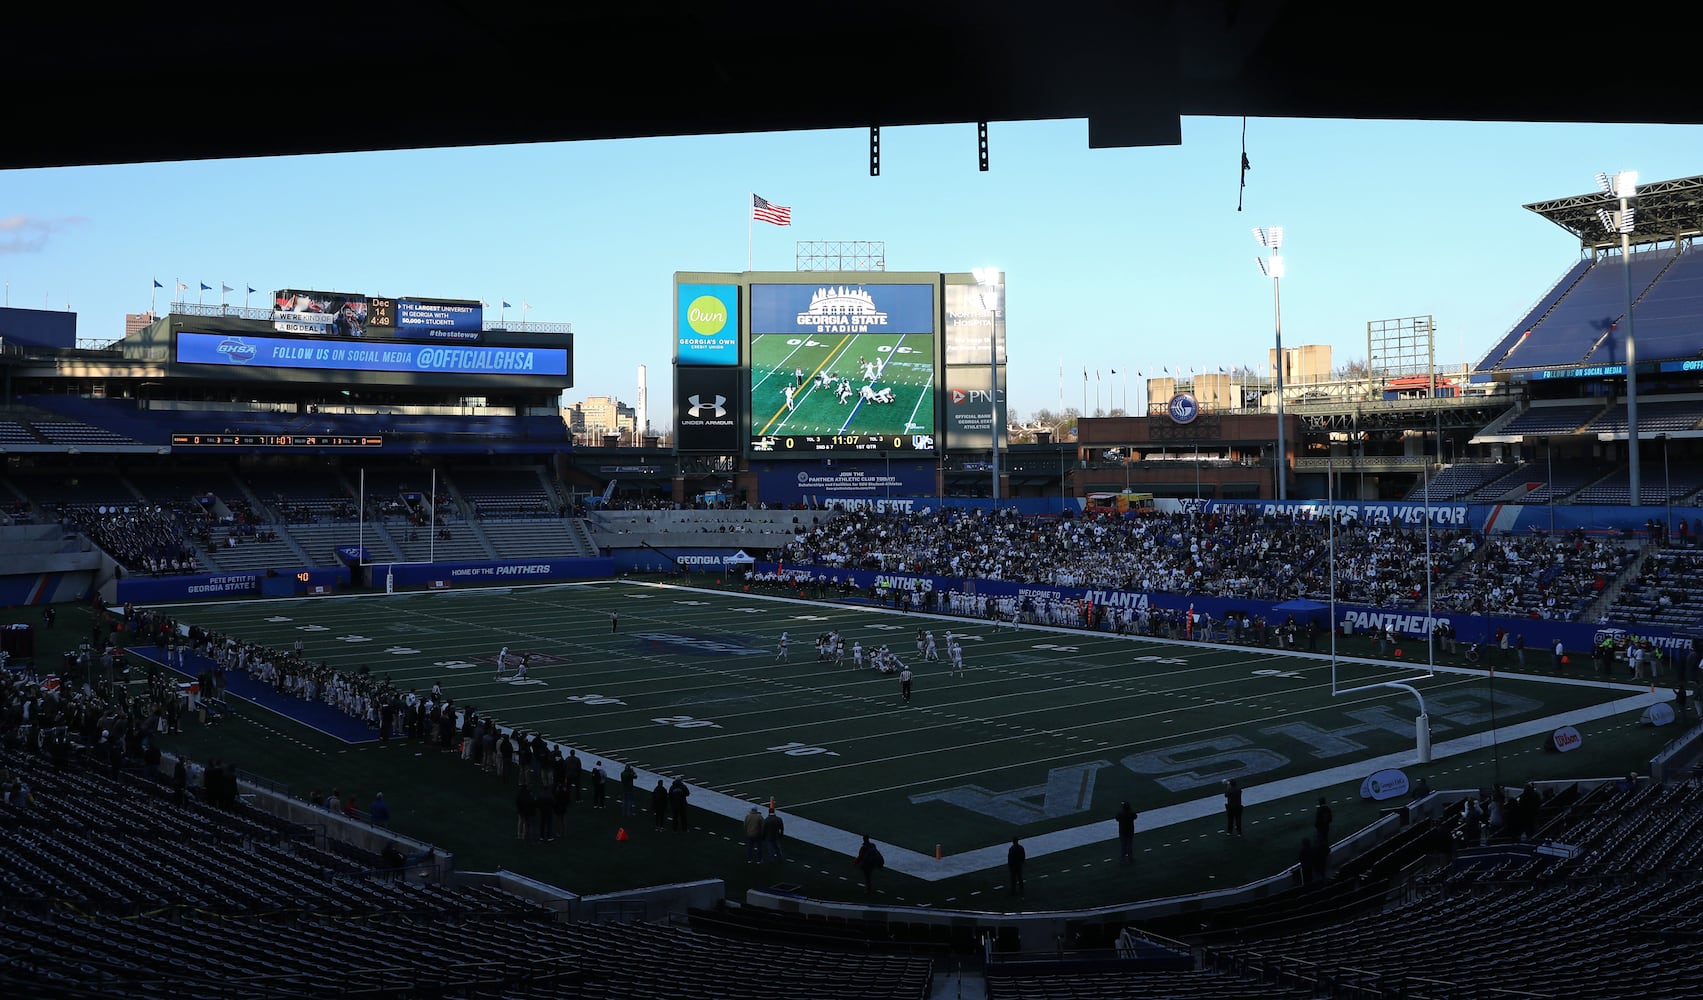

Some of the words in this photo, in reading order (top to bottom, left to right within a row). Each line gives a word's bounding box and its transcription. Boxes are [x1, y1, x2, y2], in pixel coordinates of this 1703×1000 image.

[372, 298, 390, 308] Dec
[415, 304, 441, 312] LARGEST
[280, 313, 302, 321] WE'RE
[374, 308, 386, 317] 14
[689, 308, 724, 323] Own
[370, 316, 390, 326] 4:49
[796, 315, 850, 326] GEORGIA
[851, 315, 888, 325] STATE
[954, 319, 998, 327] HOSPITA
[286, 324, 298, 332] BIG
[299, 325, 319, 333] DEAL
[817, 324, 868, 333] STADIUM
[429, 329, 479, 340] #thestateway
[218, 344, 256, 355] GHSA
[272, 346, 312, 360] FOLLOW
[316, 347, 329, 360] US
[332, 348, 344, 361] ON
[347, 349, 379, 362] SOCIAL
[382, 351, 412, 364] MEDIA
[416, 348, 534, 370] @OFFICIALGHSA
[1543, 369, 1567, 379] FOLLOW
[1574, 368, 1583, 378] ON
[1583, 367, 1604, 377] SOCIAL
[1604, 366, 1623, 375] MEDIA
[194, 436, 200, 445] 0
[234, 436, 240, 445] 2
[270, 436, 292, 445] 11:07
[306, 437, 317, 445] 29
[362, 437, 367, 445] 0
[785, 437, 795, 449] 0
[831, 435, 860, 445] 11:07
[892, 437, 902, 448] 0
[1363, 505, 1390, 523] TO
[676, 555, 721, 565] GEORGIA
[451, 567, 471, 577] HOME
[471, 567, 481, 576] OF
[481, 566, 495, 576] THE
[495, 564, 551, 576] PANTHERS
[209, 576, 227, 584] PETE
[227, 575, 247, 584] PETIT
[296, 571, 310, 583] 40
[187, 583, 224, 594] GEORGIA
[224, 582, 249, 592] STATE
[1018, 588, 1052, 599] WELCOME
[1052, 590, 1061, 600] TO
[1083, 590, 1149, 609] ATLANTA
[1555, 733, 1579, 747] Wilson
